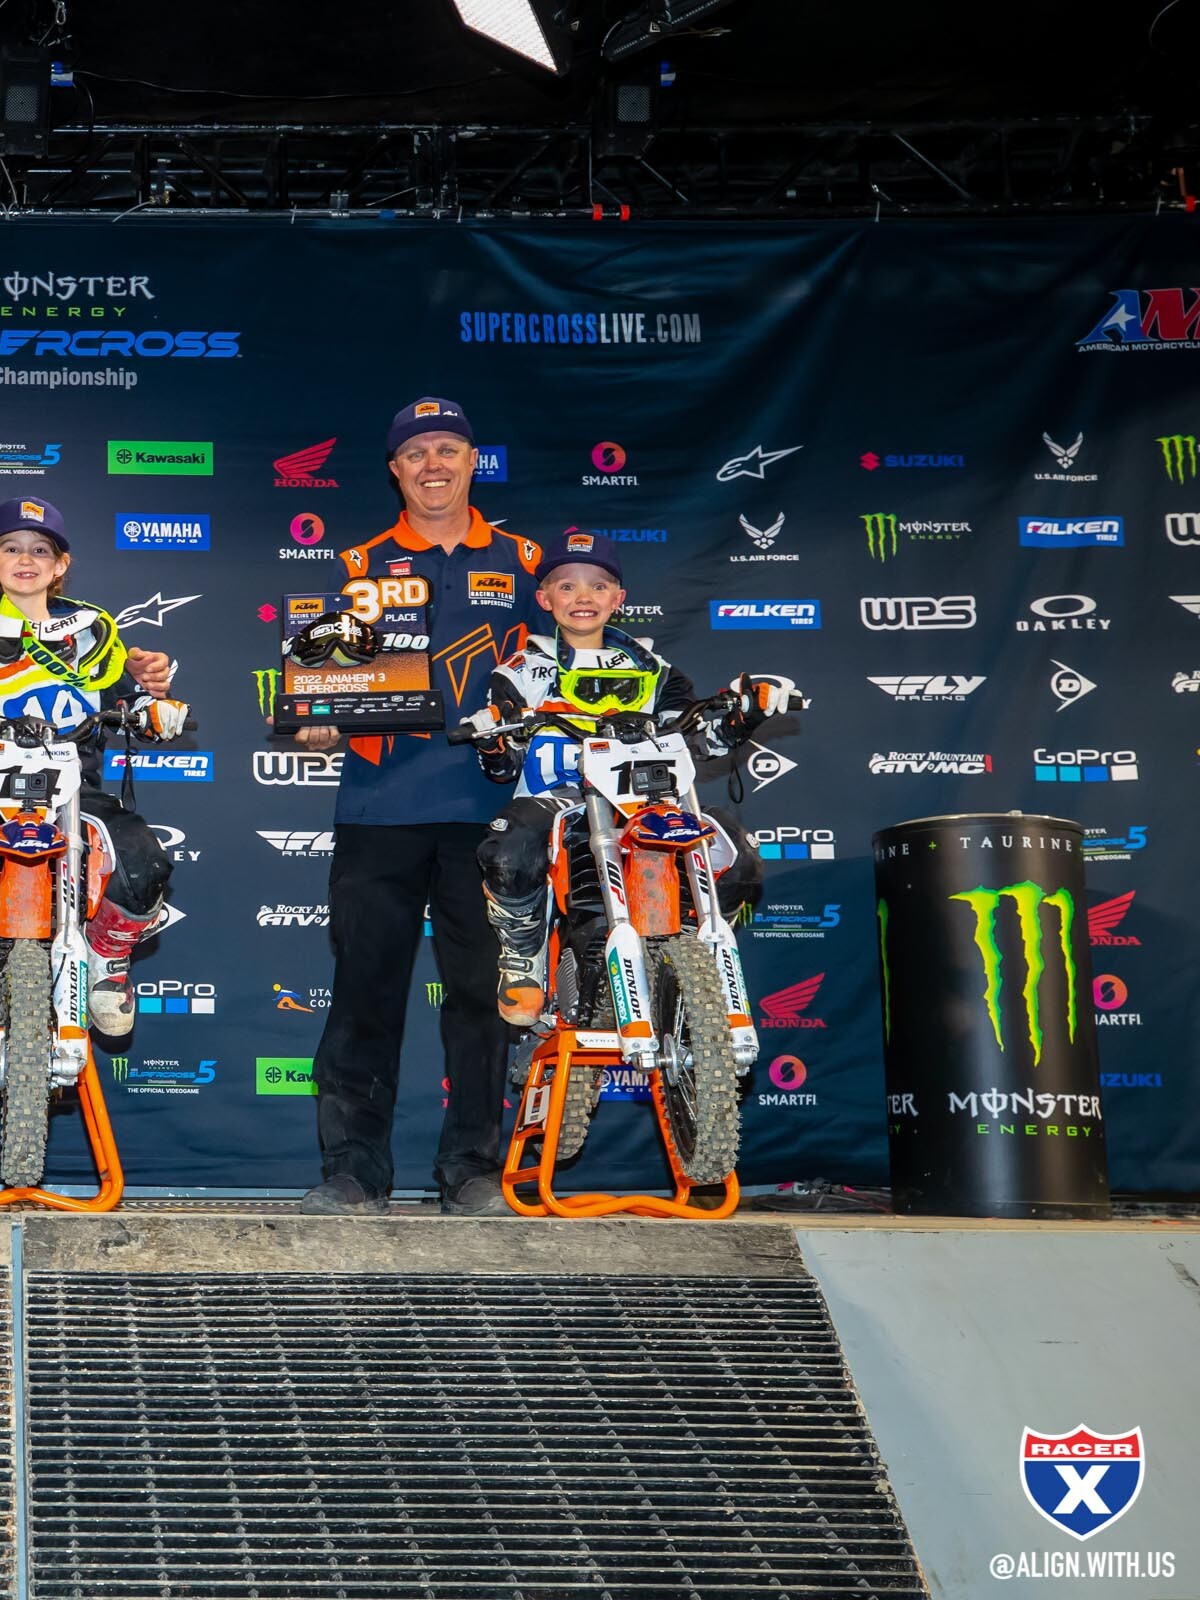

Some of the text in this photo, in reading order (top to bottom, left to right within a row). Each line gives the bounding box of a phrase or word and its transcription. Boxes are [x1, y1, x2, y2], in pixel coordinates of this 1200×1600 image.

[1, 306, 127, 317] ENERGY
[460, 311, 701, 344] SUPERCROSSLIVE.COM
[1078, 343, 1130, 353] AMERICAN
[38, 444, 62, 465] 5
[136, 452, 205, 464] Kawasaki
[884, 454, 965, 467] SUZUKI
[274, 478, 340, 488] HONDA
[1066, 474, 1098, 482] FORCE
[142, 522, 202, 538] YAMAHA
[899, 521, 972, 532] MONSTER
[1026, 520, 1120, 536] FALKEN
[476, 577, 508, 589] KTM
[342, 578, 428, 623] 3RD
[496, 592, 513, 600] TEAM
[294, 602, 319, 610] KTM
[480, 600, 513, 609] SUPERCROSS
[717, 604, 815, 617] FALKEN
[385, 612, 418, 622] PLACE
[860, 595, 977, 631] WPS
[1016, 619, 1111, 632] OAKLEY
[382, 632, 430, 650] 100
[28, 643, 84, 688] 100%
[293, 673, 386, 685] 2022 ANAHEIM 3
[293, 683, 369, 694] SUPERCROSS
[23, 689, 88, 728] 14
[111, 756, 208, 769] FALKEN
[887, 751, 984, 762] ROCKY MOUNTAIN
[1033, 749, 1138, 765] GoPro
[662, 829, 700, 839] KTM
[1123, 826, 1149, 849] 5
[13, 839, 50, 849] KTM
[959, 835, 1073, 853] TAURINE
[275, 904, 313, 913] ROCKY
[818, 904, 842, 928] 5
[722, 949, 741, 1011] DUNLOP
[70, 960, 79, 1024] DUNLOP
[623, 958, 642, 1020] DUNLOP
[760, 1018, 827, 1028] HONDA
[191, 1060, 218, 1083] 5
[948, 1087, 1102, 1120] MONSTER
[977, 1123, 1091, 1137] ENERGY
